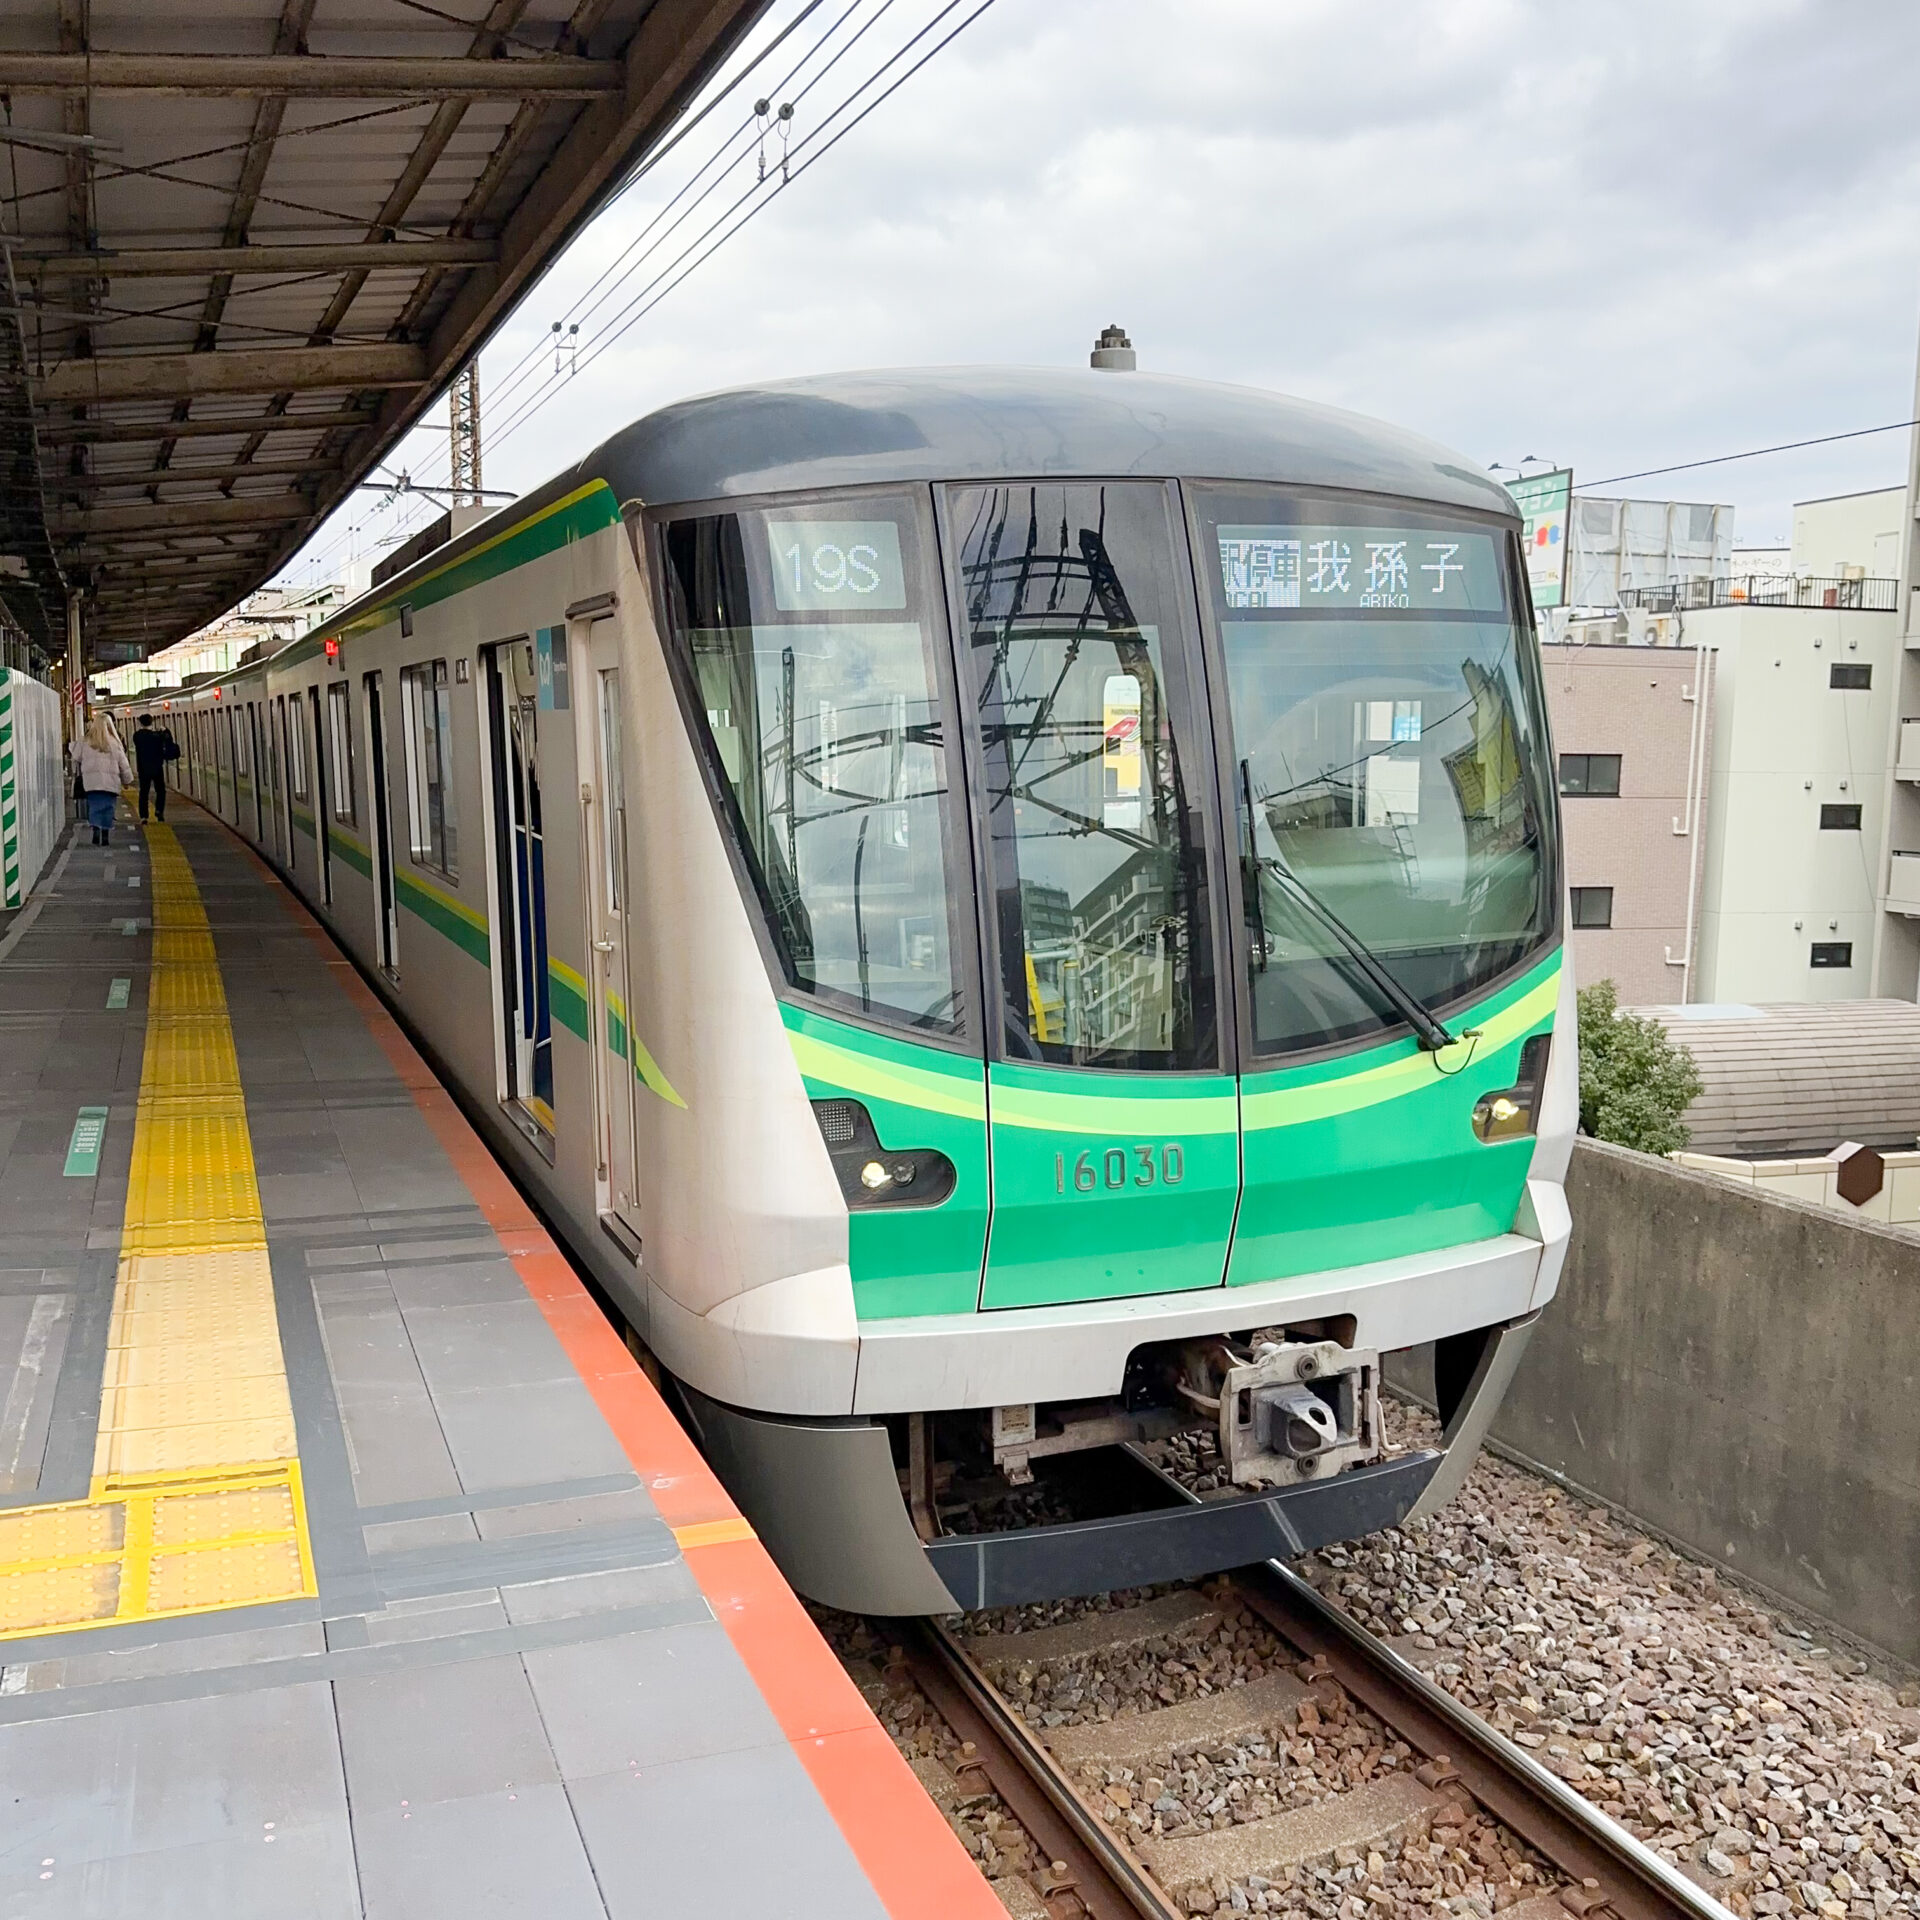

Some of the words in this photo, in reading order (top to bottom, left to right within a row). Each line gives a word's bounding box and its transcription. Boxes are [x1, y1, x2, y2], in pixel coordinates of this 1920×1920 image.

[785, 543, 880, 593] 19S
[1307, 540, 1464, 592] 我孫子
[1360, 593, 1409, 609] ABIKO
[1055, 1142, 1185, 1194] 16030
